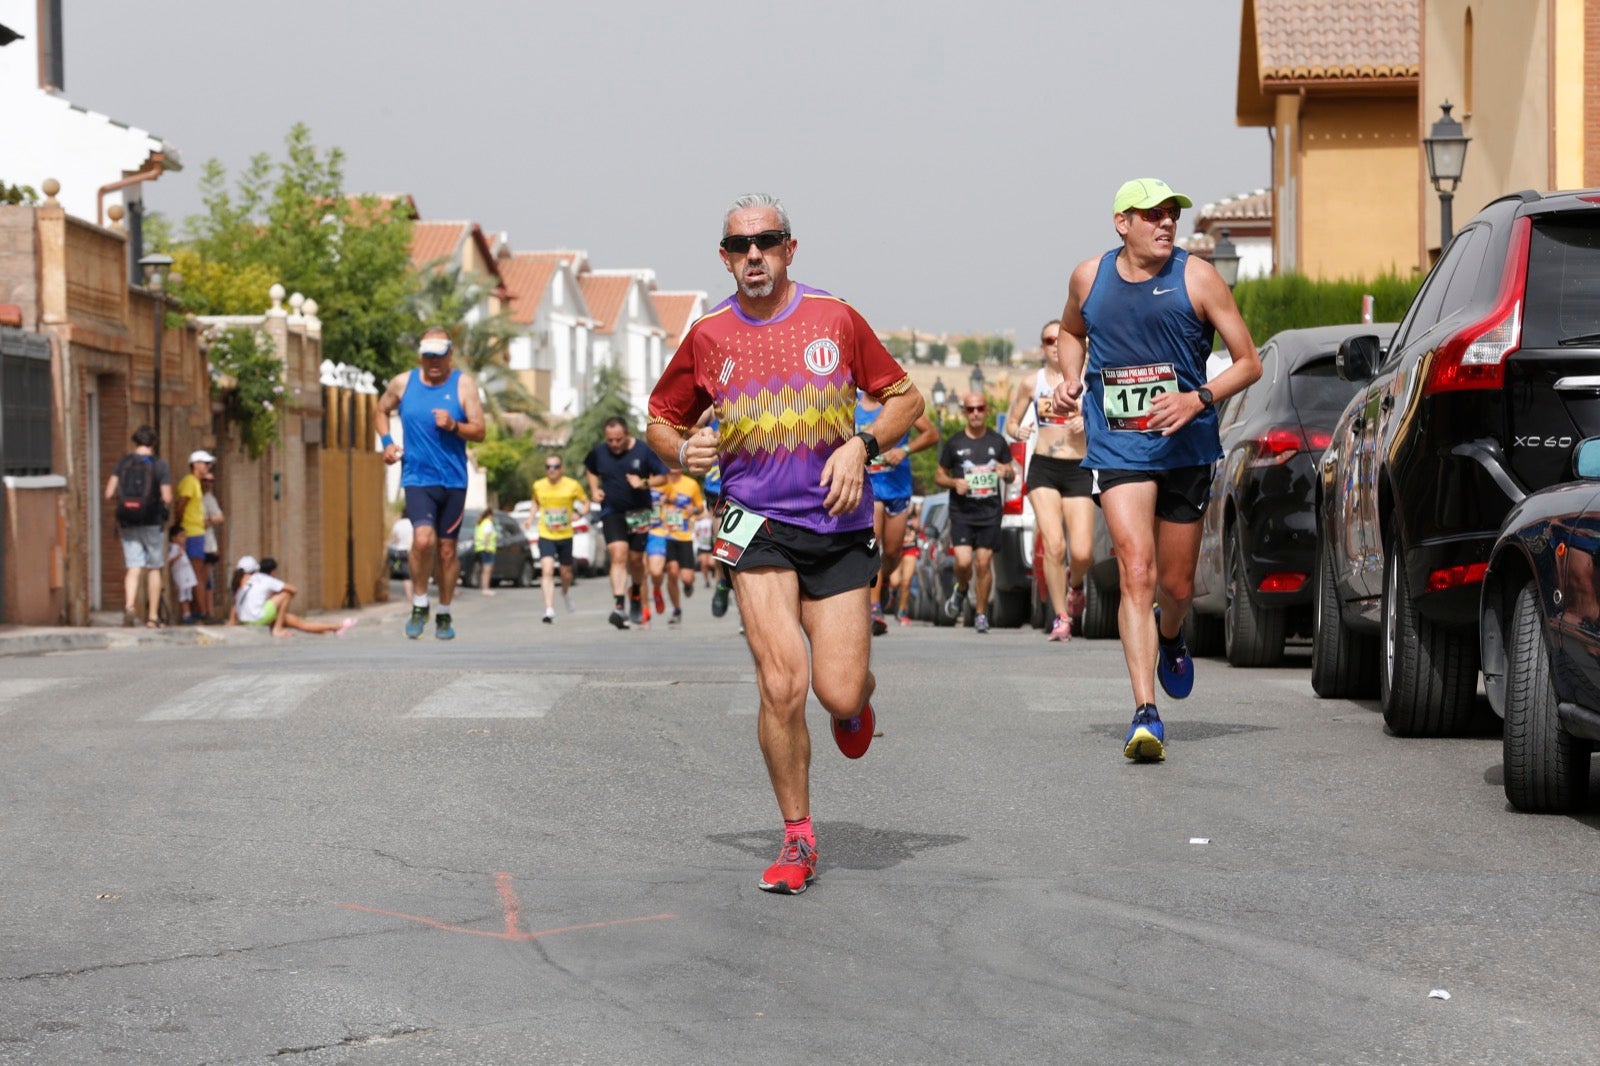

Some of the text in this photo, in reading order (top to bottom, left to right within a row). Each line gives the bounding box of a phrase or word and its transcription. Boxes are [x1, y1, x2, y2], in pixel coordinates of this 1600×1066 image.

[1513, 435, 1572, 448] XC 60
[972, 474, 994, 486] 495
